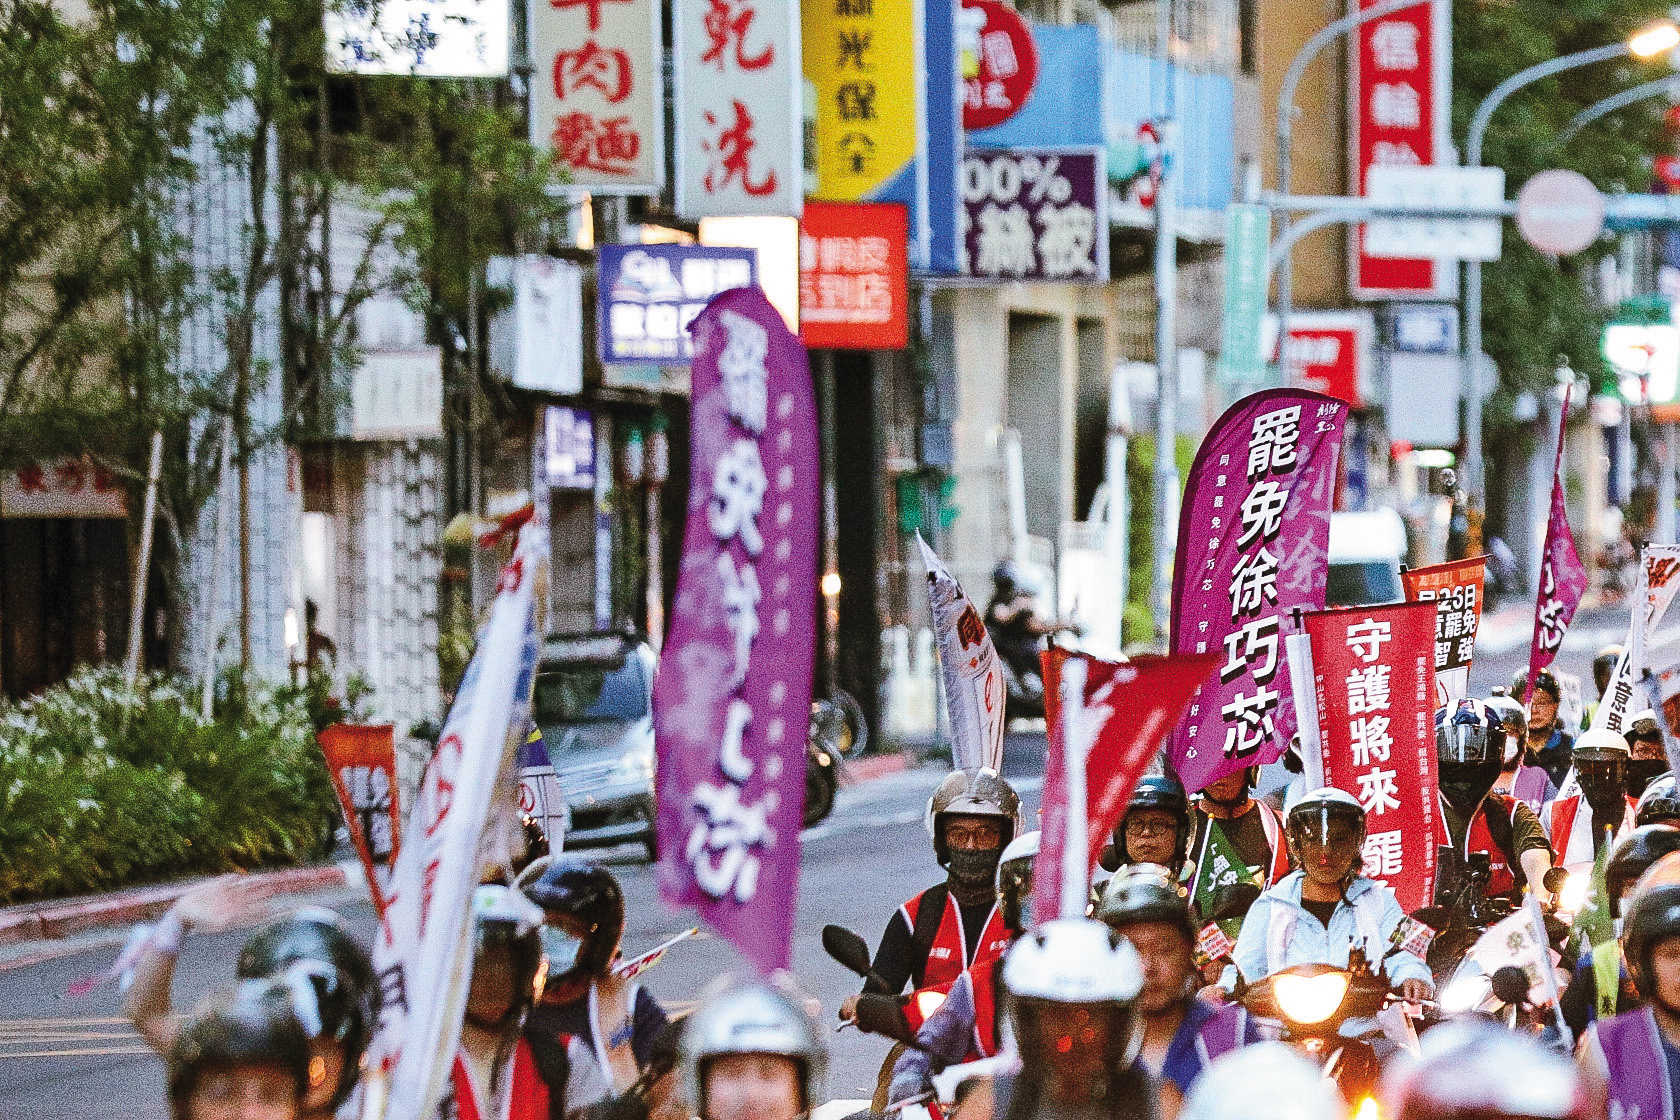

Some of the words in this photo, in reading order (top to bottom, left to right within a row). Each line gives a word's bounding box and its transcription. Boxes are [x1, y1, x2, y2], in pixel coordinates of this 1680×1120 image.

[701, 0, 777, 196] 乾洗
[962, 201, 1096, 279] 絲被
[1220, 404, 1302, 754] 罷免徐巧芯
[1346, 617, 1402, 815] 守護將來
